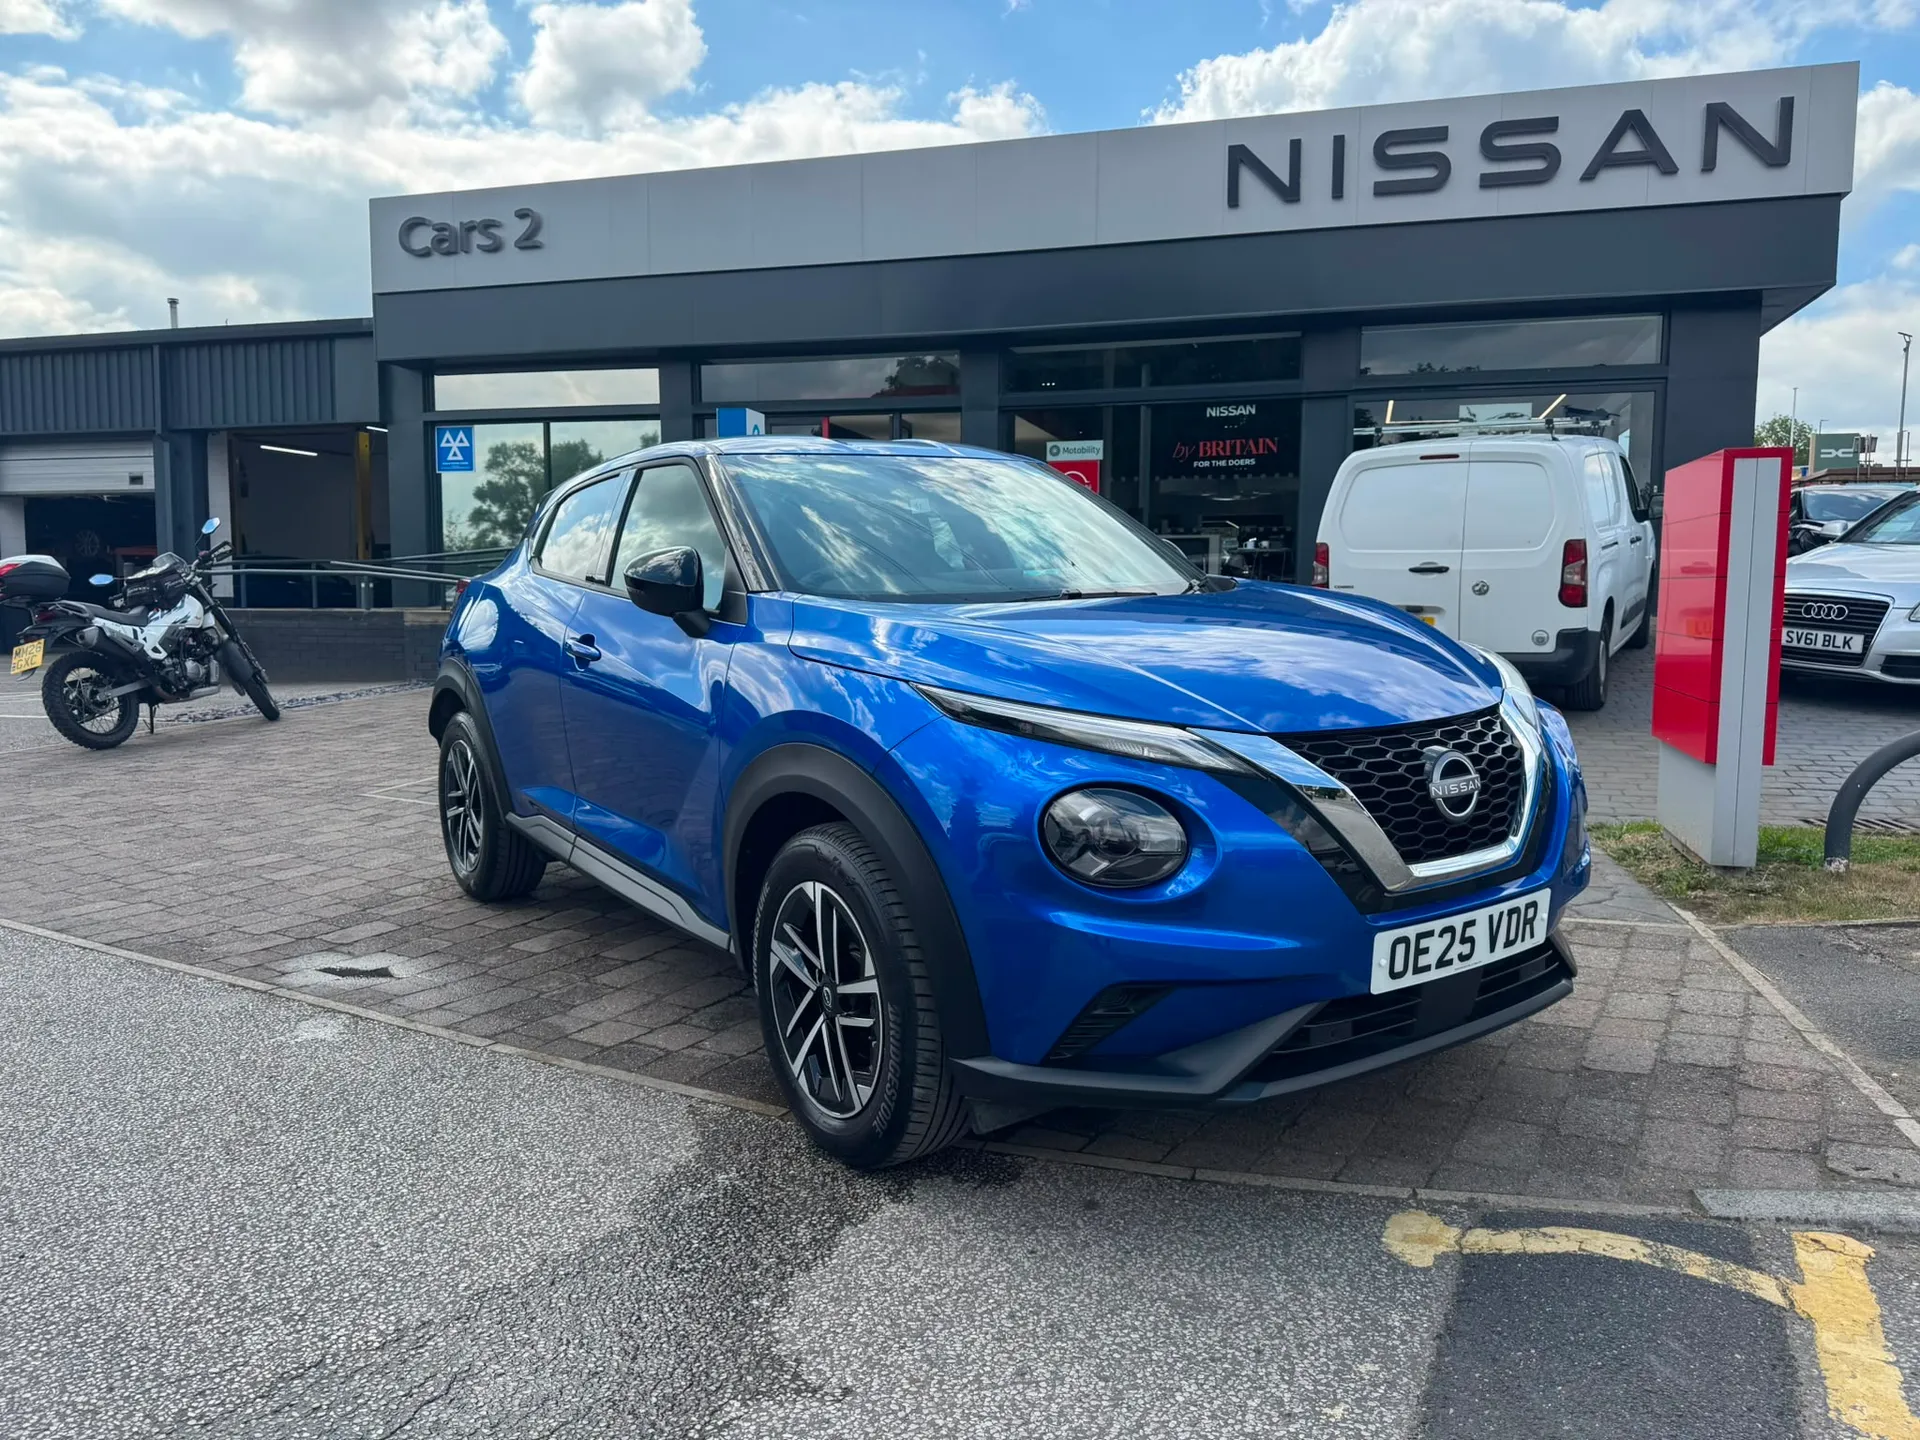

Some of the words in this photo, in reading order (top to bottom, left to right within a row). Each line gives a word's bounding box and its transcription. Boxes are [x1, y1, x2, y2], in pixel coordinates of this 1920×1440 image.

[1227, 96, 1795, 208] NISSAN
[398, 216, 504, 258] Cars
[513, 207, 544, 251] 2
[1206, 404, 1256, 417] NISSAN
[1062, 446, 1101, 455] Motability
[1172, 441, 1196, 463] by
[1199, 437, 1279, 457] BRITAIN
[1193, 460, 1210, 468] FOR
[1211, 459, 1227, 467] THE
[1228, 458, 1256, 467] DOERS
[1785, 630, 1818, 647] SV61
[1821, 633, 1853, 650] BLK
[1431, 778, 1481, 796] NISSAN
[1388, 918, 1477, 981] OE25
[1488, 900, 1539, 954] VDR
[872, 1001, 901, 1139] BRIDGESTONE
